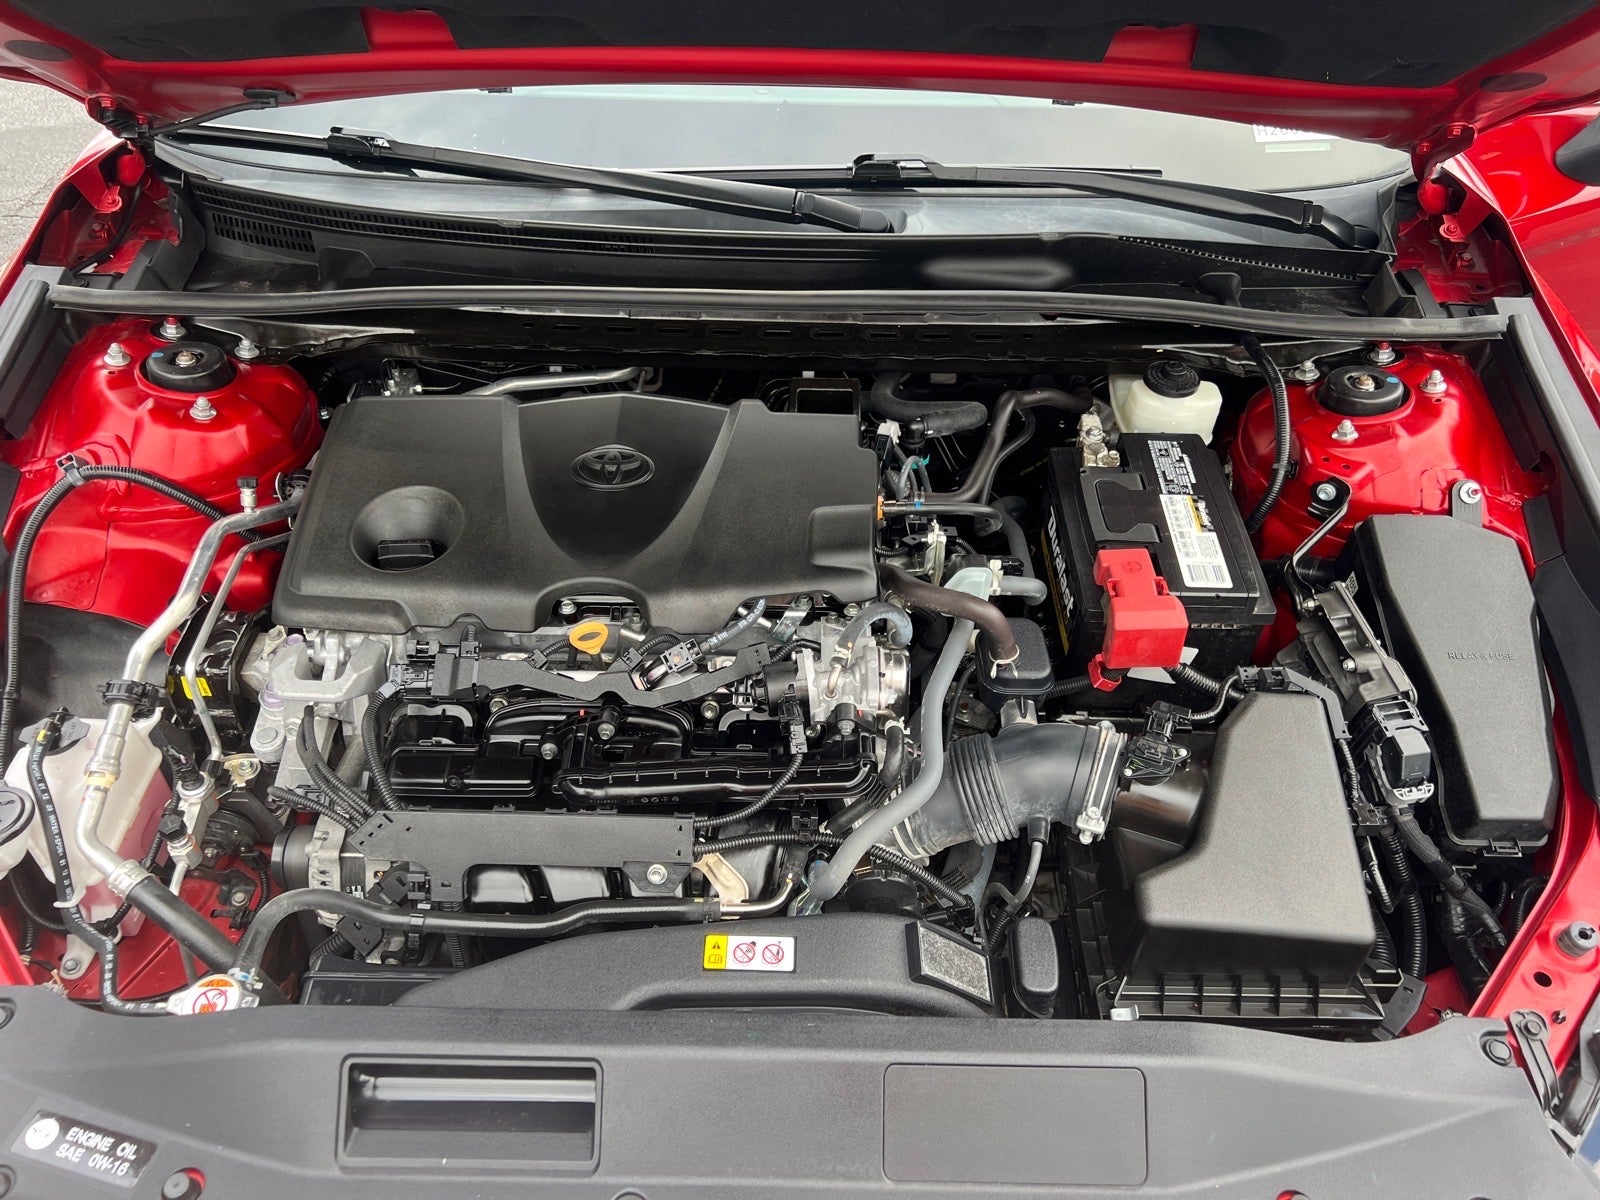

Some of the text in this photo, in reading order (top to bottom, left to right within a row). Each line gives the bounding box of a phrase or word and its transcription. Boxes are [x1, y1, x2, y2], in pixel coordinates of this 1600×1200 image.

[1048, 506, 1074, 618] Duralast
[1447, 651, 1479, 660] RELAY
[1489, 652, 1514, 661] FUSE
[48, 813, 60, 834] WATER
[55, 1143, 130, 1176] SAE 0W-16
[65, 1126, 138, 1160] ENGINE OIL
